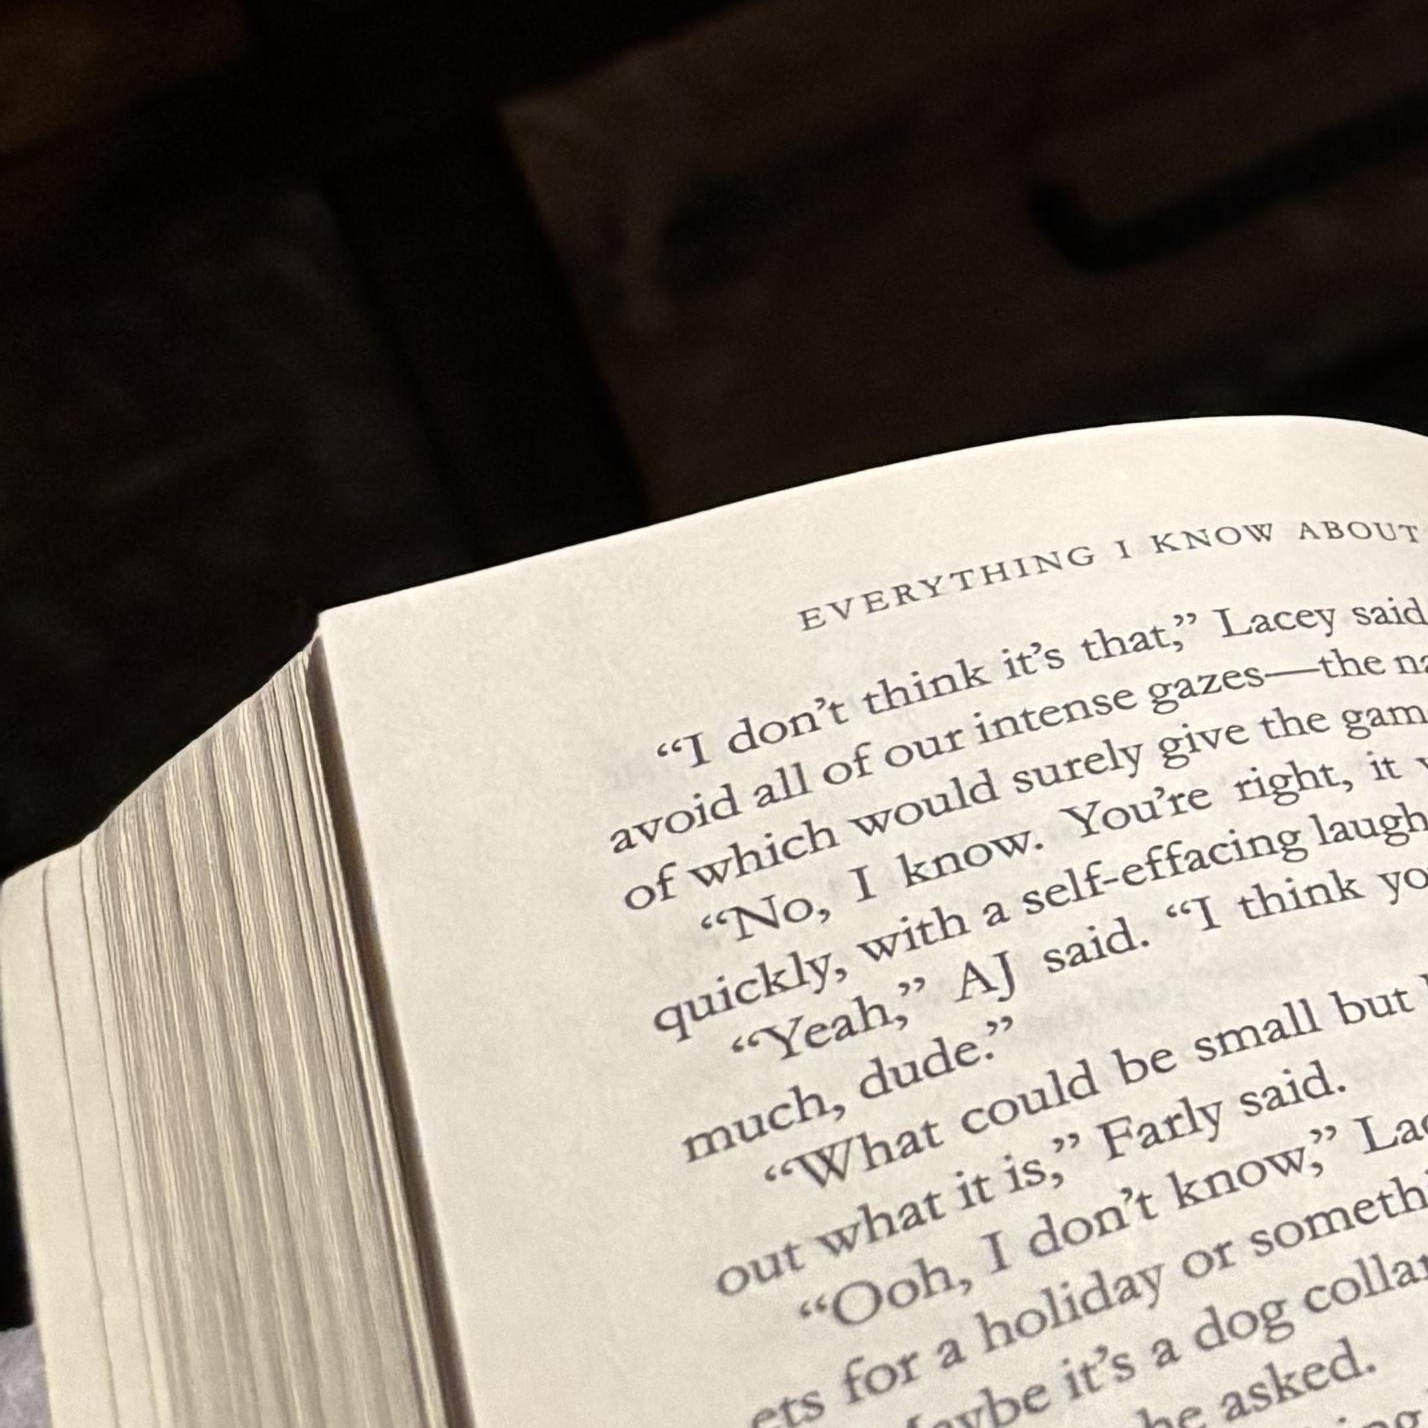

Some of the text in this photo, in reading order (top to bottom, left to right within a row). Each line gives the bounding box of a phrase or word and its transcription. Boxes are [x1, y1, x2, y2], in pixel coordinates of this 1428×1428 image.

[797, 546, 1095, 632] EVERYTHING
[1150, 522, 1273, 554] KNOW
[1298, 520, 1419, 543] ABOUT
[727, 696, 849, 754] don’t
[861, 658, 992, 715] think
[1001, 641, 1065, 680] it’s
[1080, 612, 1197, 662] that,”
[1212, 607, 1336, 638] Lacey
[609, 782, 743, 854] avoid
[752, 761, 813, 809] all
[822, 741, 874, 786] of
[884, 728, 965, 768] our
[973, 689, 1138, 745] intense
[624, 861, 677, 911] of
[686, 818, 841, 888] which
[847, 767, 1001, 837] would
[1012, 738, 1144, 794] surely
[1157, 722, 1250, 770] give
[1258, 706, 1331, 740] the
[895, 829, 1044, 888] know.
[1058, 785, 1213, 839] You’re
[1233, 759, 1354, 807] right,
[1366, 750, 1403, 781] it
[653, 950, 848, 1043] quickly,
[855, 905, 972, 962] with
[1022, 828, 1309, 916] self-effacing
[731, 976, 926, 1061] “Yeah,”
[954, 950, 1016, 1003] AJ
[1042, 916, 1150, 974] said.
[1237, 868, 1366, 920] think
[682, 1015, 1014, 1164] much, dude.”
[763, 1120, 945, 1189] “What
[960, 1058, 1101, 1135] could
[1110, 1048, 1178, 1086] be
[1194, 997, 1324, 1063] small
[1327, 988, 1415, 1026] but
[716, 1059, 1347, 1296] out what it Farly said.
[1028, 1186, 1159, 1258] don’t
[1165, 1124, 1337, 1210] know,”
[843, 1351, 919, 1405] for
[974, 1263, 1165, 1353] holiday
[1181, 1240, 1236, 1279] or
[1062, 1344, 1136, 1401] it’s
[1193, 1299, 1295, 1352] dog
[1220, 1336, 1377, 1423] asked.
